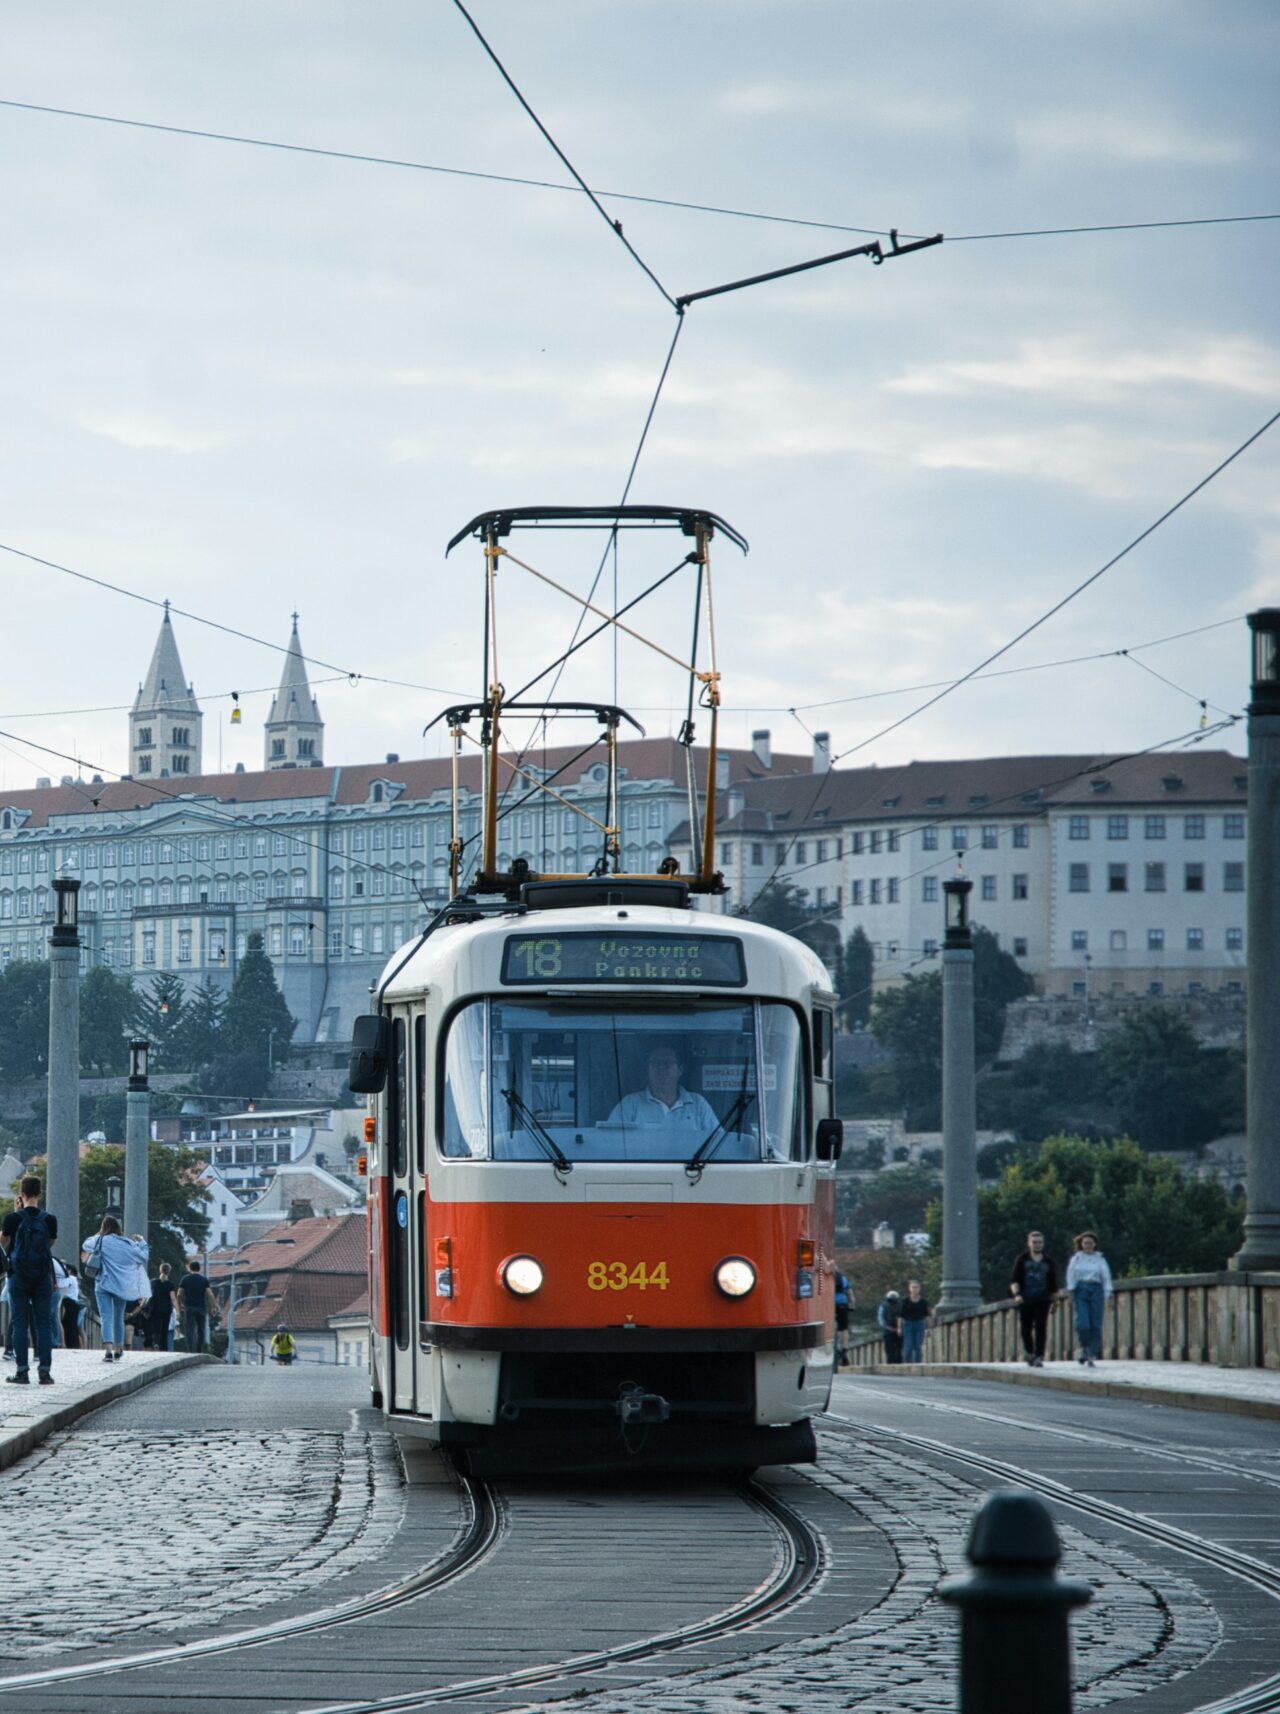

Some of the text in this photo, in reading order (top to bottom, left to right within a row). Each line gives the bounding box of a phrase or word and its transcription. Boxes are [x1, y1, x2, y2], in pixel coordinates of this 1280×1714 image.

[515, 939, 562, 977] 18
[600, 941, 699, 958] Vozovna
[595, 960, 703, 978] Pankrác
[587, 1261, 671, 1291] 8344
